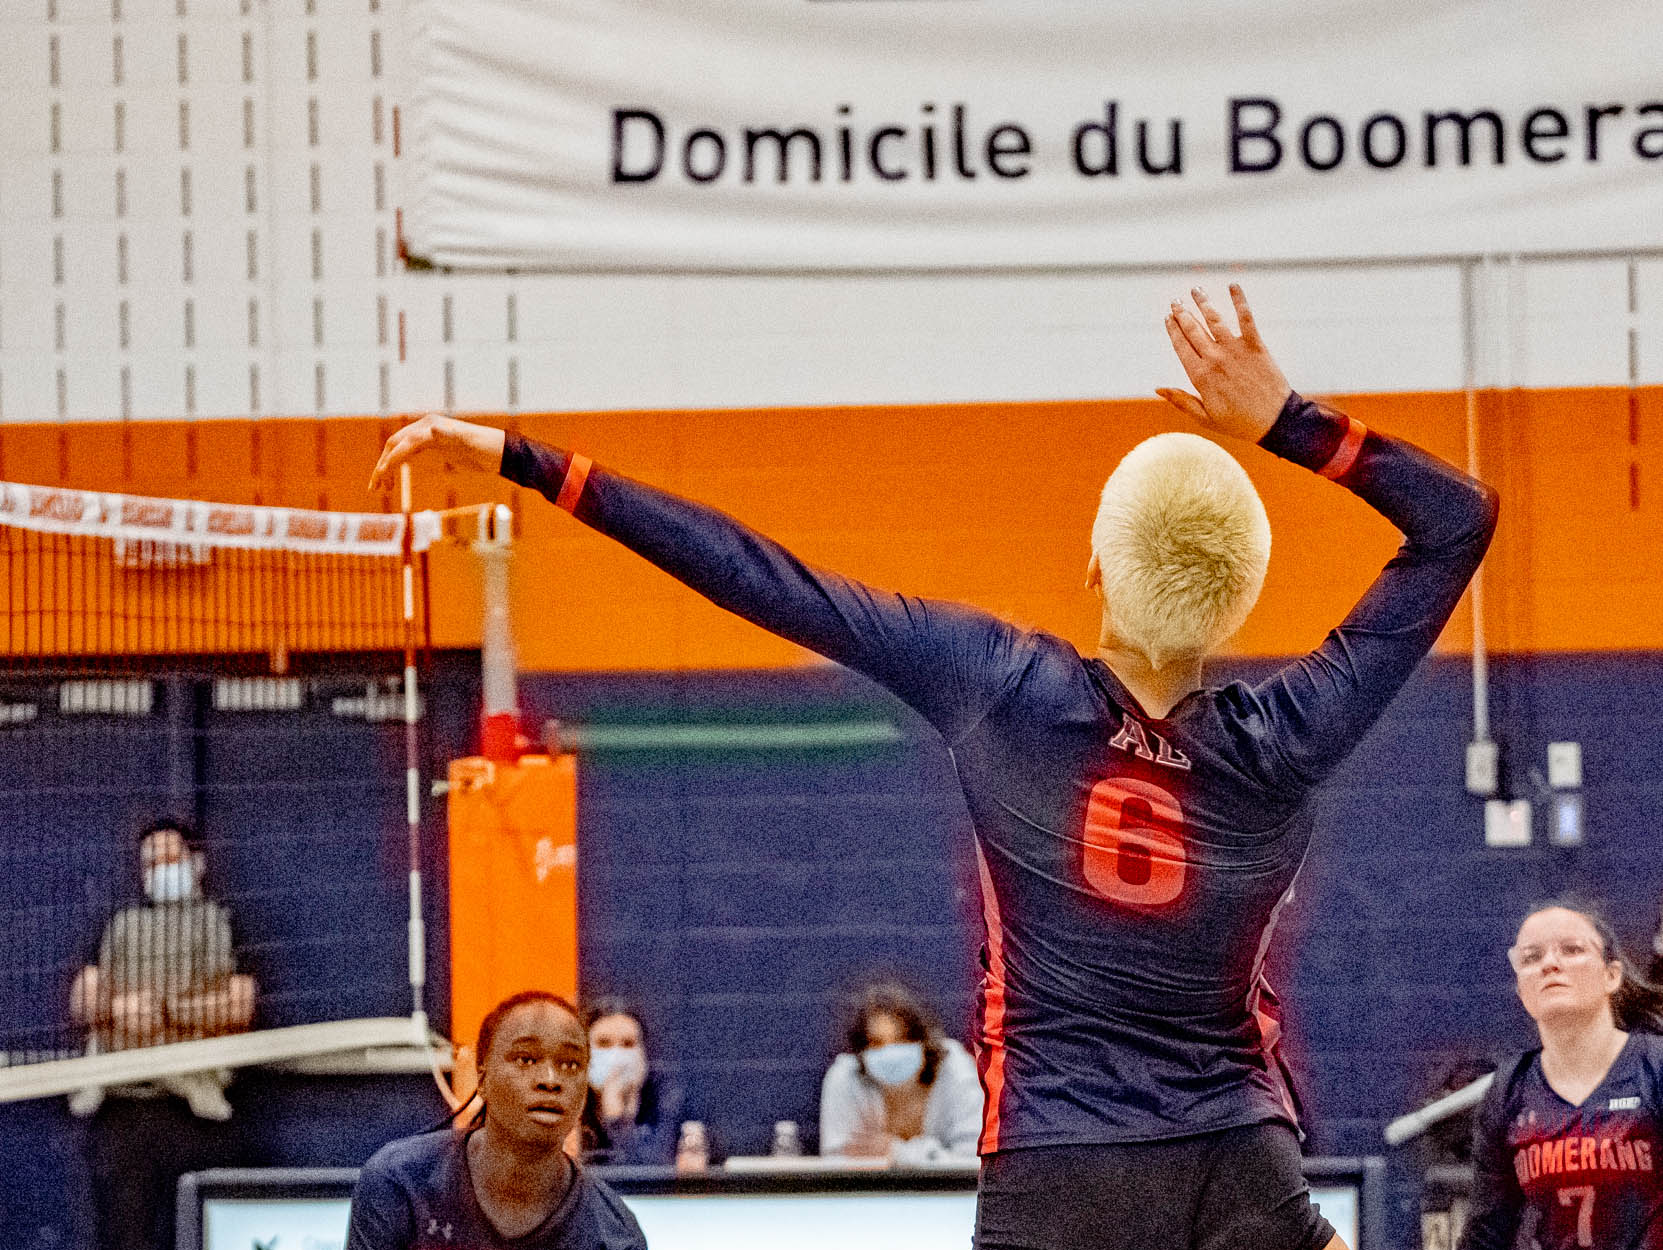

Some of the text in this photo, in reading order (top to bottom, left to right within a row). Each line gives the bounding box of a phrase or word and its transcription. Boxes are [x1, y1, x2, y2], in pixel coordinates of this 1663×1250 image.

[609, 104, 1033, 186] Domicile
[1071, 102, 1184, 178] du
[1109, 712, 1191, 769] AL
[1083, 776, 1186, 905] 6
[1556, 1186, 1596, 1248] 7
